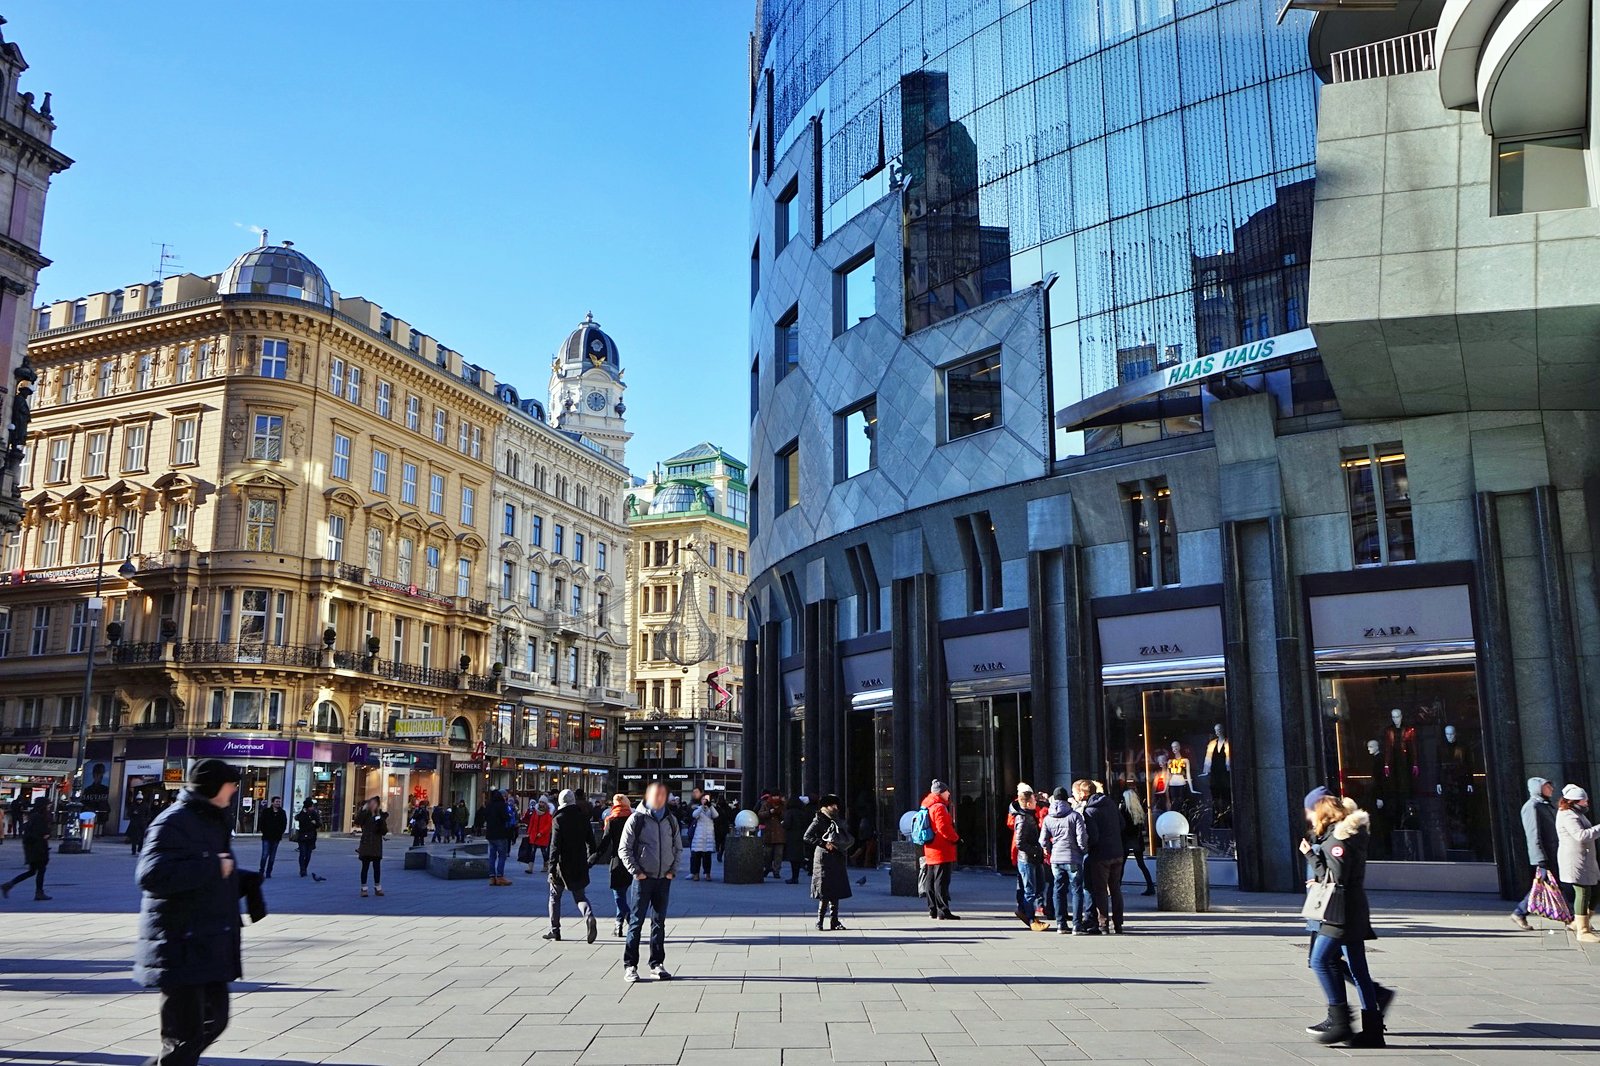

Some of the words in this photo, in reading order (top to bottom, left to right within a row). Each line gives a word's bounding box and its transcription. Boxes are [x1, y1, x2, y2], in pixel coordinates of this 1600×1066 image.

[1168, 357, 1215, 385] HAAS
[1222, 339, 1275, 369] HAUS
[1364, 626, 1416, 637] ZARA
[1139, 644, 1183, 656] ZARA
[973, 662, 1006, 672] ZARA
[861, 678, 884, 687] ZARA
[223, 741, 265, 751] Marionnaud
[16, 756, 42, 764] WIENER
[455, 762, 481, 770] APOTHEKE
